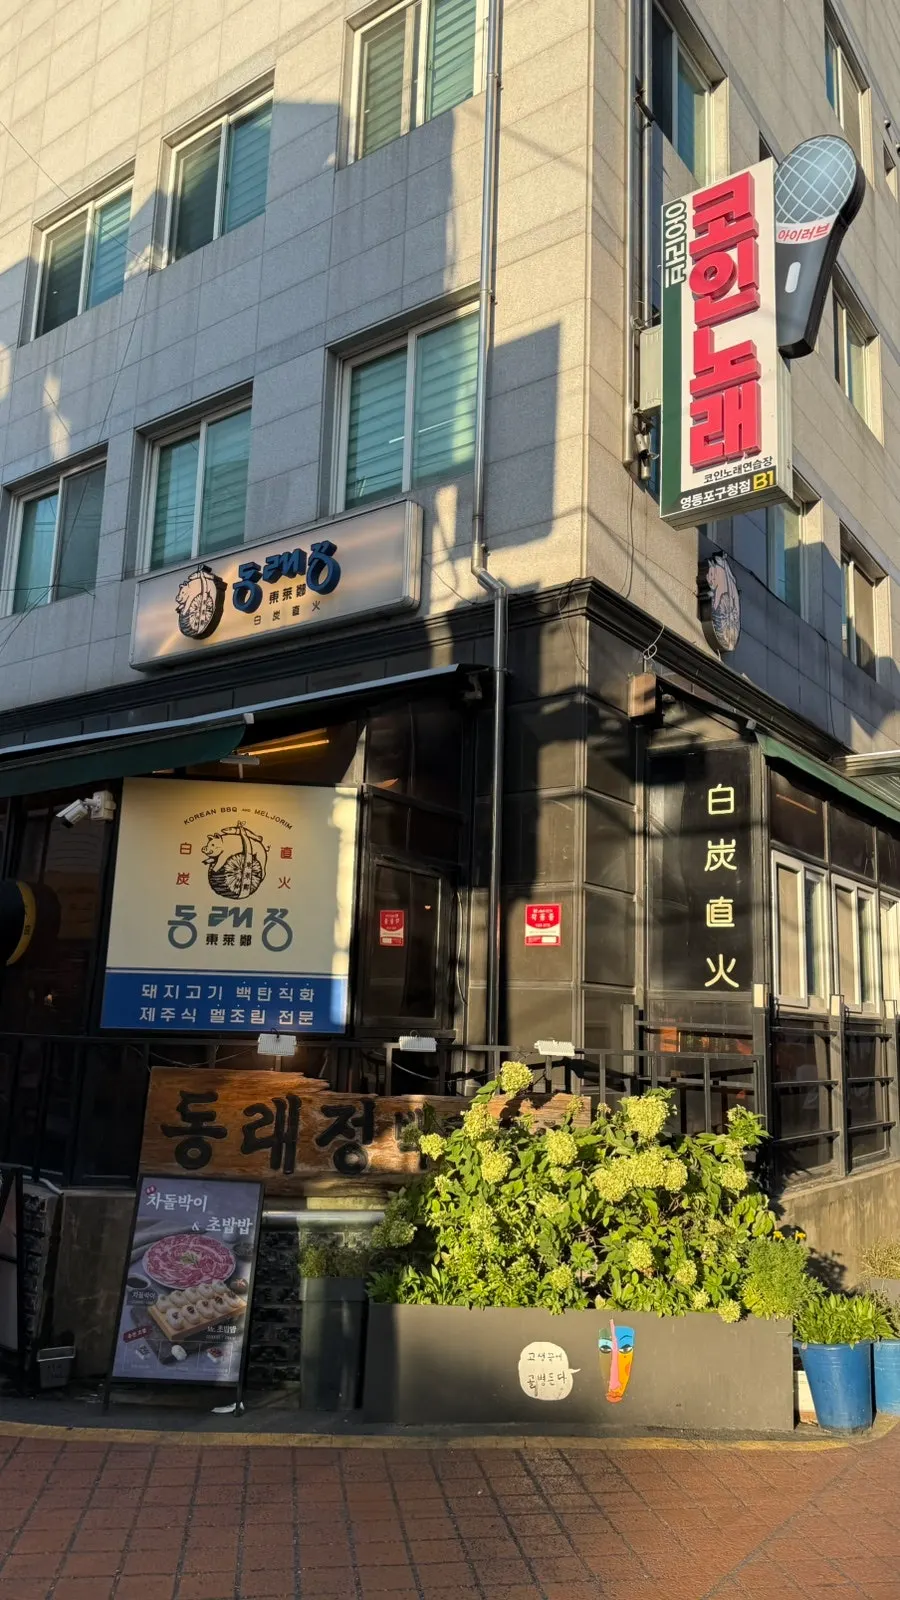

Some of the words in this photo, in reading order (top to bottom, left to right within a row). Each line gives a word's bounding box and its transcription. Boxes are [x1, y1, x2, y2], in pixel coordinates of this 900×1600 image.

[777, 223, 831, 242] 아이러브
[664, 201, 687, 289] 아이러브
[689, 171, 761, 472] 코인노래
[704, 456, 773, 483] 코인노래연습장
[680, 479, 751, 510] 영등포구청점
[753, 470, 774, 491] B1
[183, 809, 217, 825] KOREAN
[254, 809, 293, 830] MELJORIM
[704, 783, 740, 989] 白炭直火
[140, 984, 223, 1000] 돼지고기
[236, 985, 315, 1002] 백탄직화
[139, 1006, 197, 1023] 제주식
[210, 1008, 266, 1024] 멜조림
[278, 1010, 314, 1026] 전문
[146, 1192, 208, 1212] 차돌박이
[205, 1216, 254, 1235] 초밥밥
